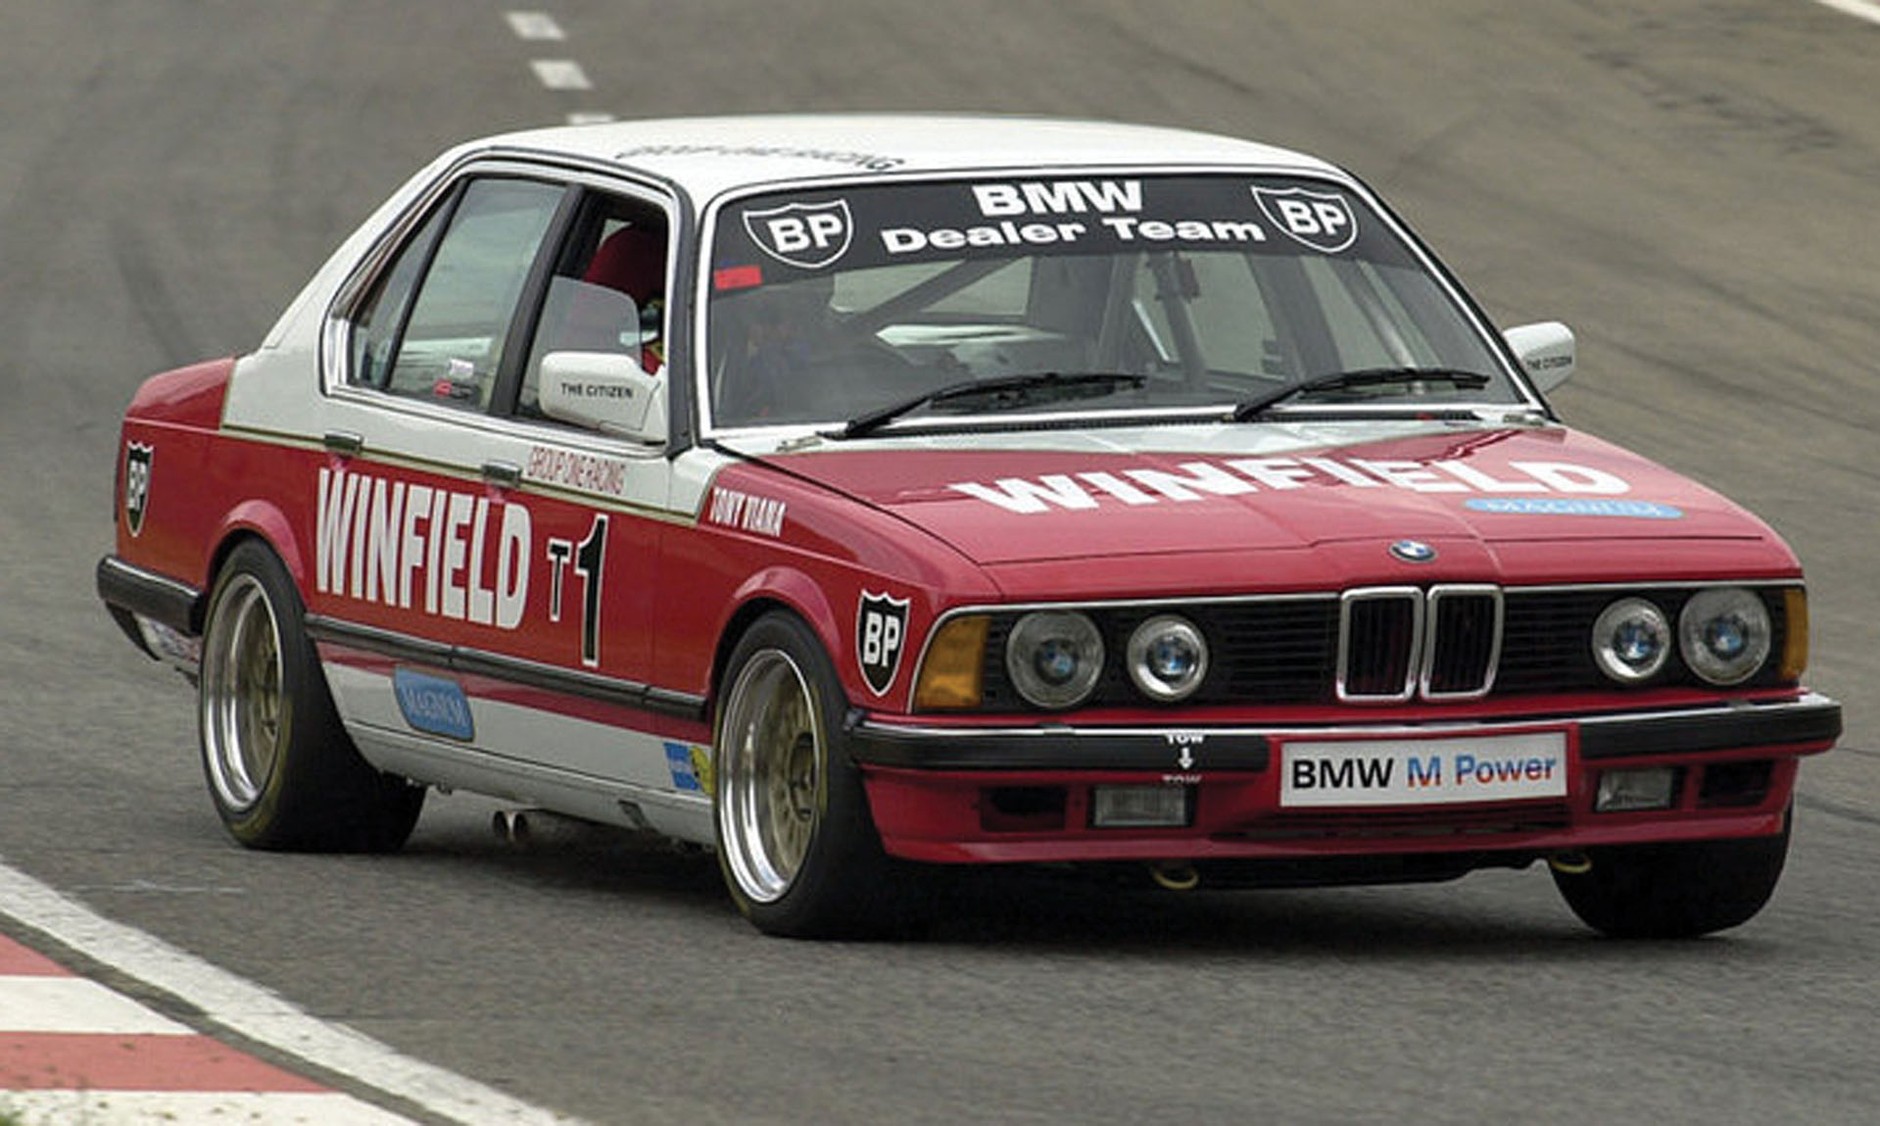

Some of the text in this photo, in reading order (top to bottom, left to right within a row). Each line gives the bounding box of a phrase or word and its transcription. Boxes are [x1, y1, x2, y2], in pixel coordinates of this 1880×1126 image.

[971, 180, 1143, 216] BMW
[766, 214, 844, 253] BP
[880, 217, 1267, 254] Dealer Team
[1275, 199, 1348, 236] BP
[561, 382, 633, 399] THE CITIZEN
[951, 457, 1631, 514] WINFIELD
[316, 467, 531, 630] WINFIELD
[863, 610, 901, 668] BP
[1292, 753, 1557, 790] BMW M Power
